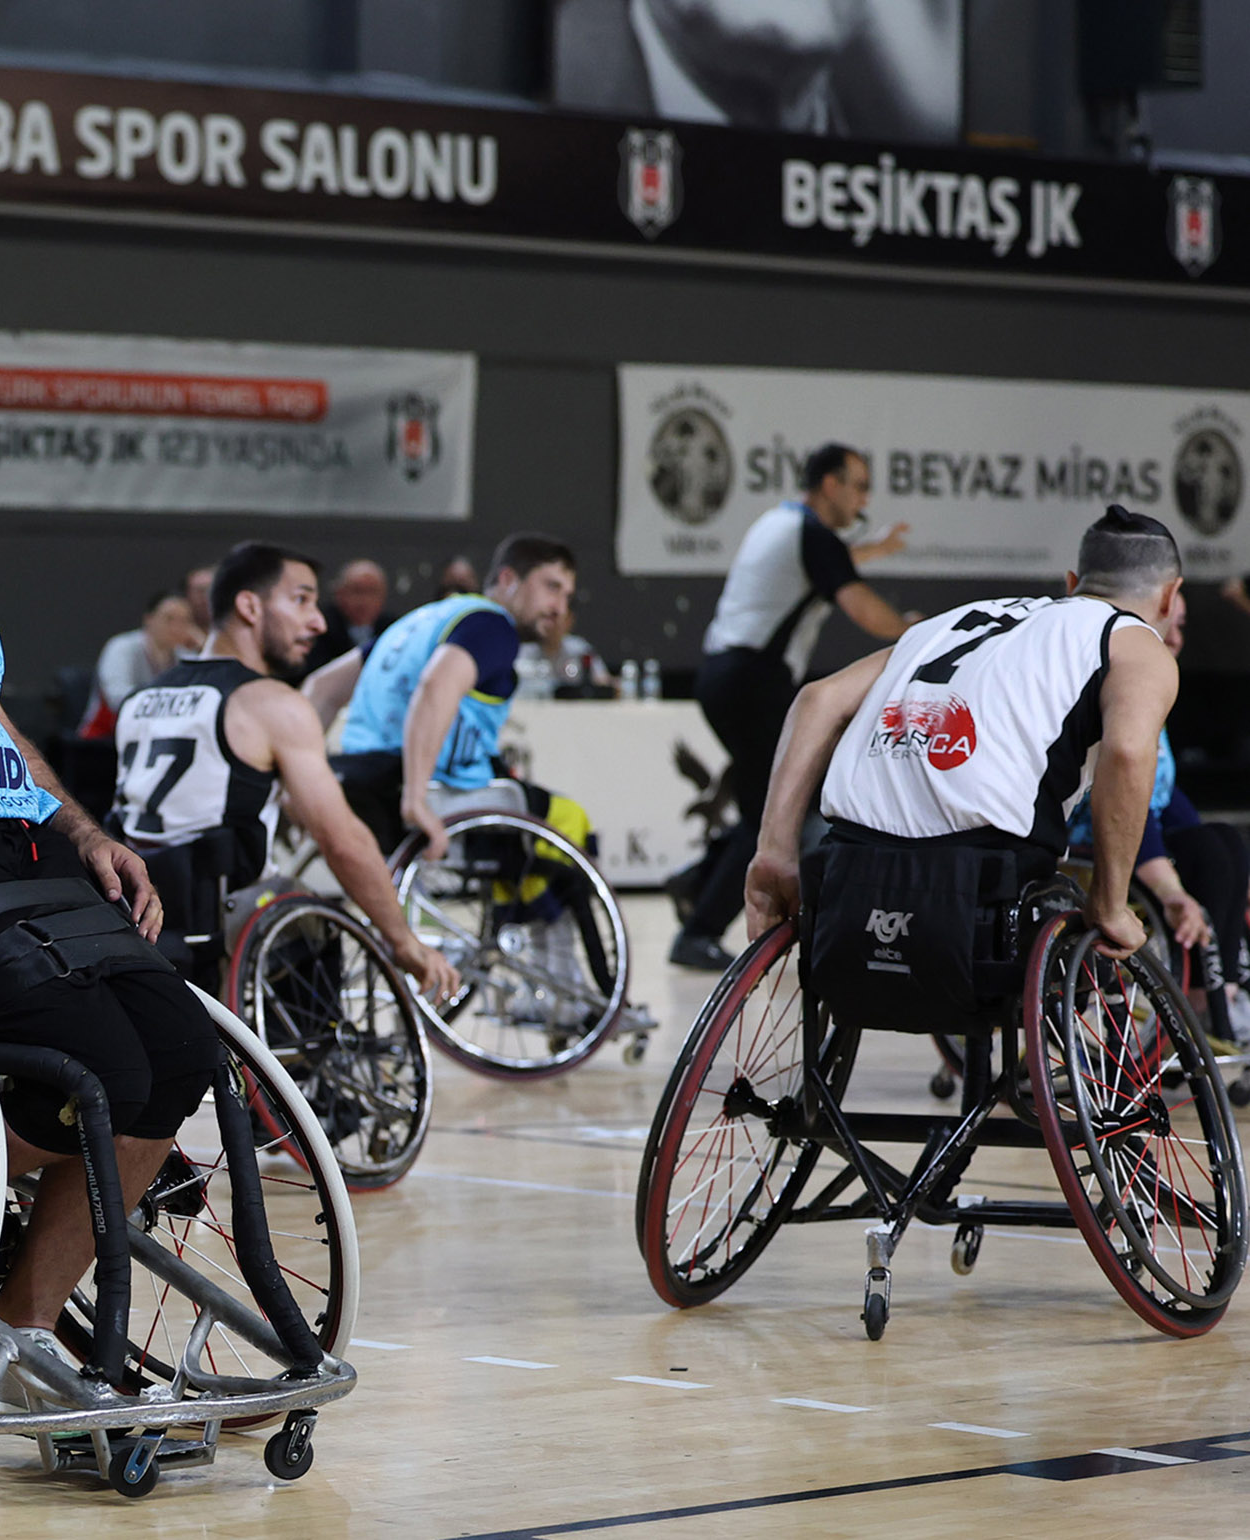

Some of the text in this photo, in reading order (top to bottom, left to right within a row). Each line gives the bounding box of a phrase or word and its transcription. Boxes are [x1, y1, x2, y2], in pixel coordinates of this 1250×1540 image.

[74, 104, 247, 187] SPOR
[260, 118, 499, 205] SALONU
[782, 153, 1082, 257] BEŞİKTAŞ JK
[888, 451, 1025, 496] BEYAZ
[1035, 443, 1162, 502] MİRAS
[865, 908, 914, 944] RGK
